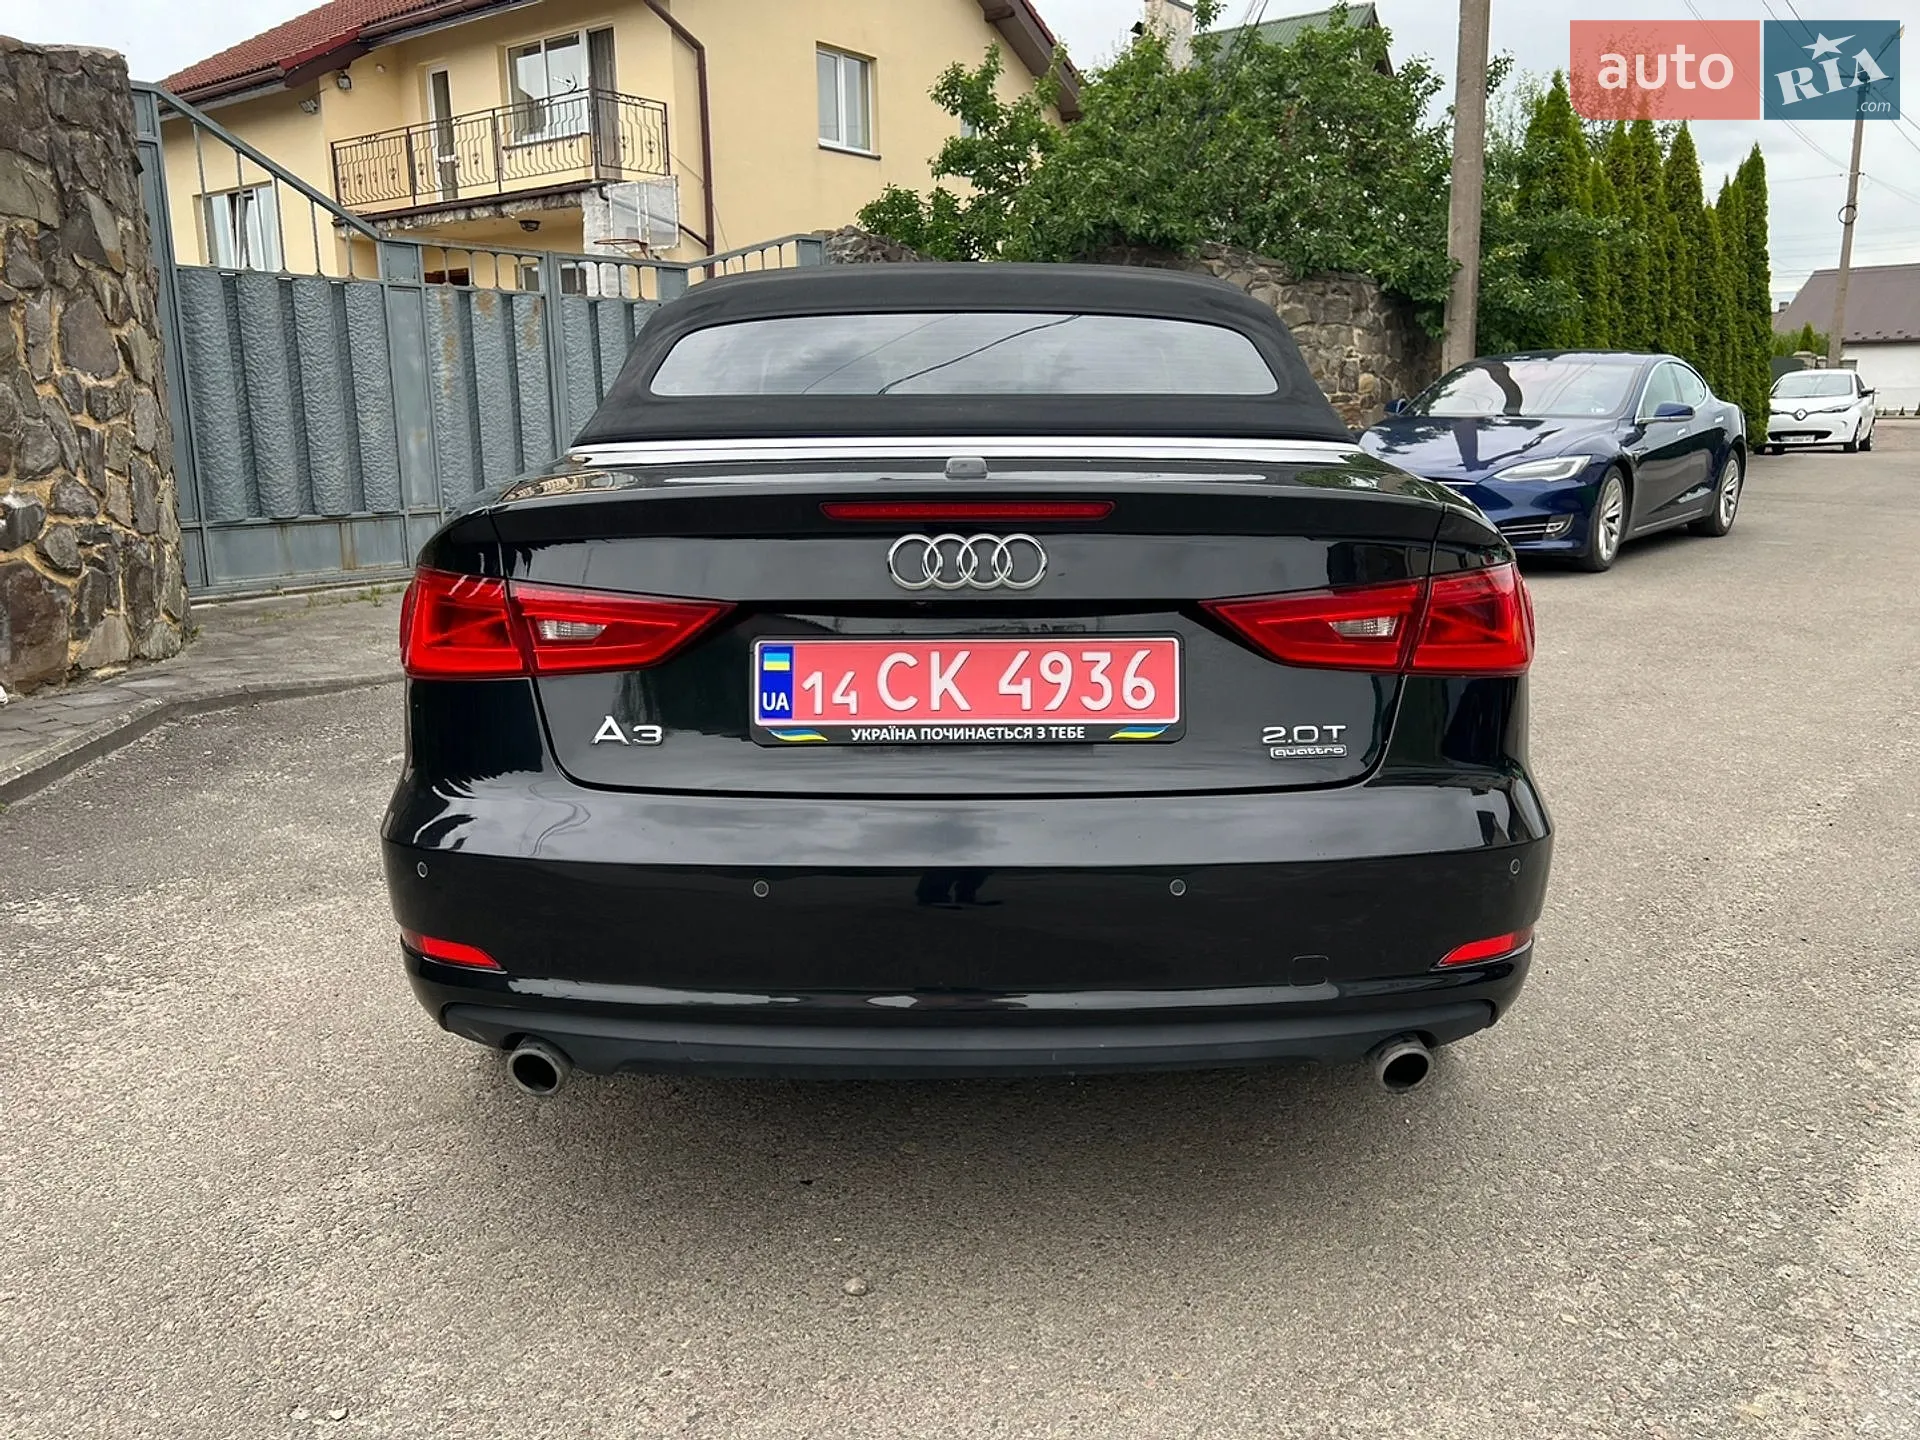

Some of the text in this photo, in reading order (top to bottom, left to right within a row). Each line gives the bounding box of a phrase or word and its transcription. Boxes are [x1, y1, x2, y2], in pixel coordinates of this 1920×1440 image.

[802, 671, 858, 715] 14
[998, 649, 1156, 711] 4936
[762, 692, 790, 711] UA
[591, 715, 663, 745] A3
[851, 725, 917, 741] УКРАЇНА
[920, 727, 1031, 740] ПОЧИНАЄТЬСЯ
[1049, 727, 1085, 739] ТЕБЕ
[1262, 725, 1347, 744] 2.0T
[1274, 747, 1344, 757] quattro
